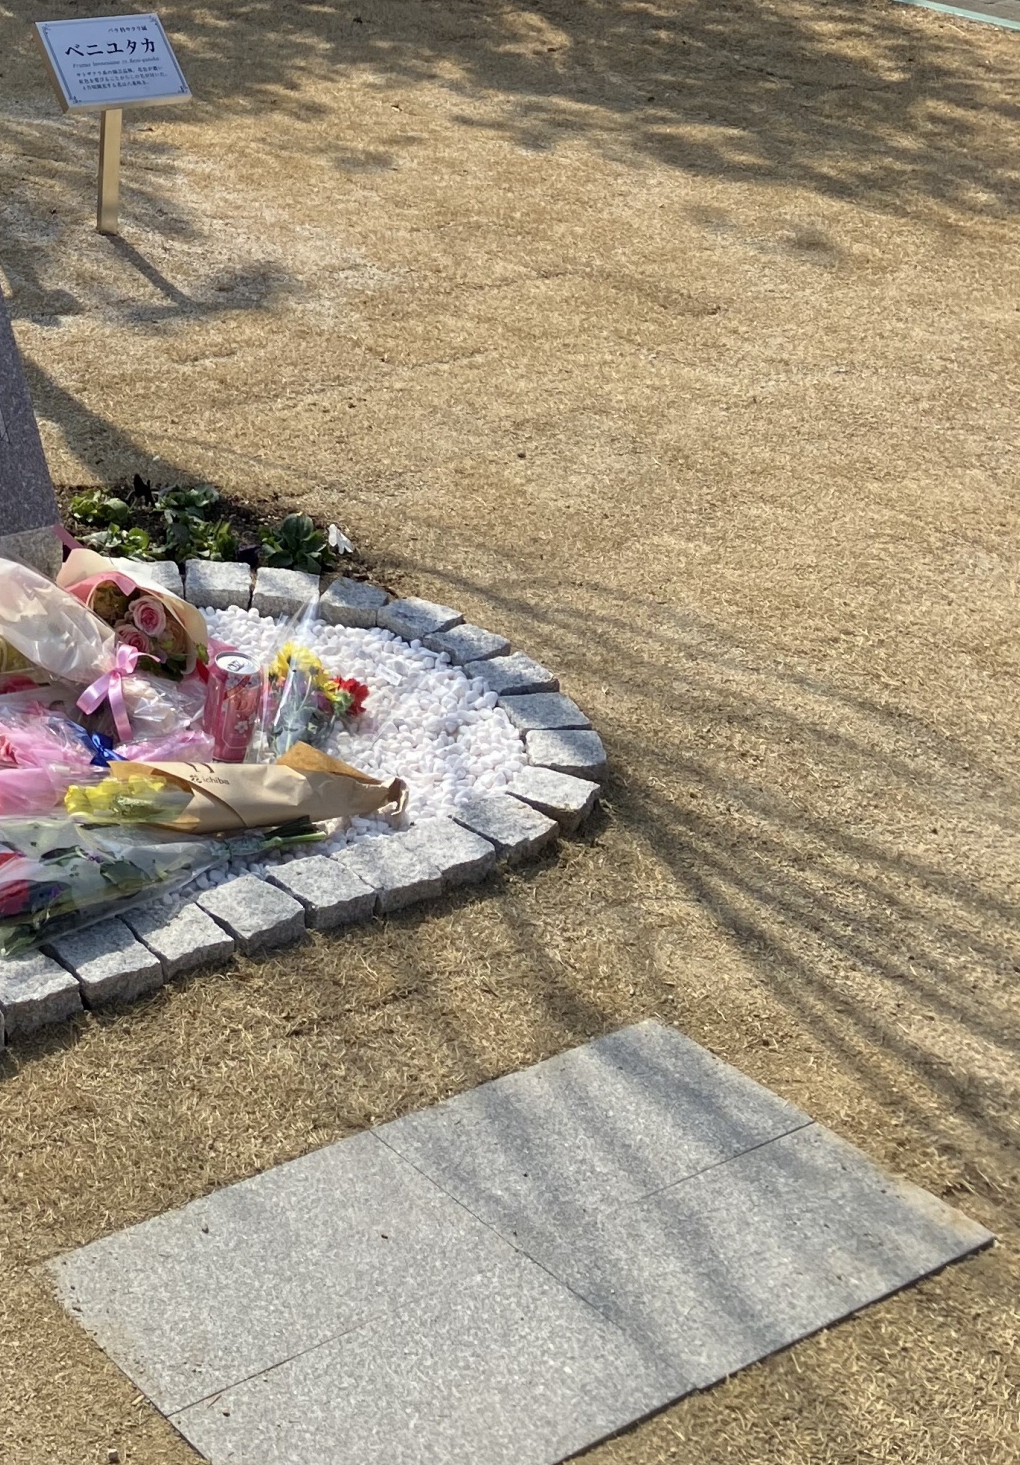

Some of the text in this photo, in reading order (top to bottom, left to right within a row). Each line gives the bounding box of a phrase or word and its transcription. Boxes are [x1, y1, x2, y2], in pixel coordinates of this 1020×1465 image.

[65, 37, 155, 56] ベニユタカ
